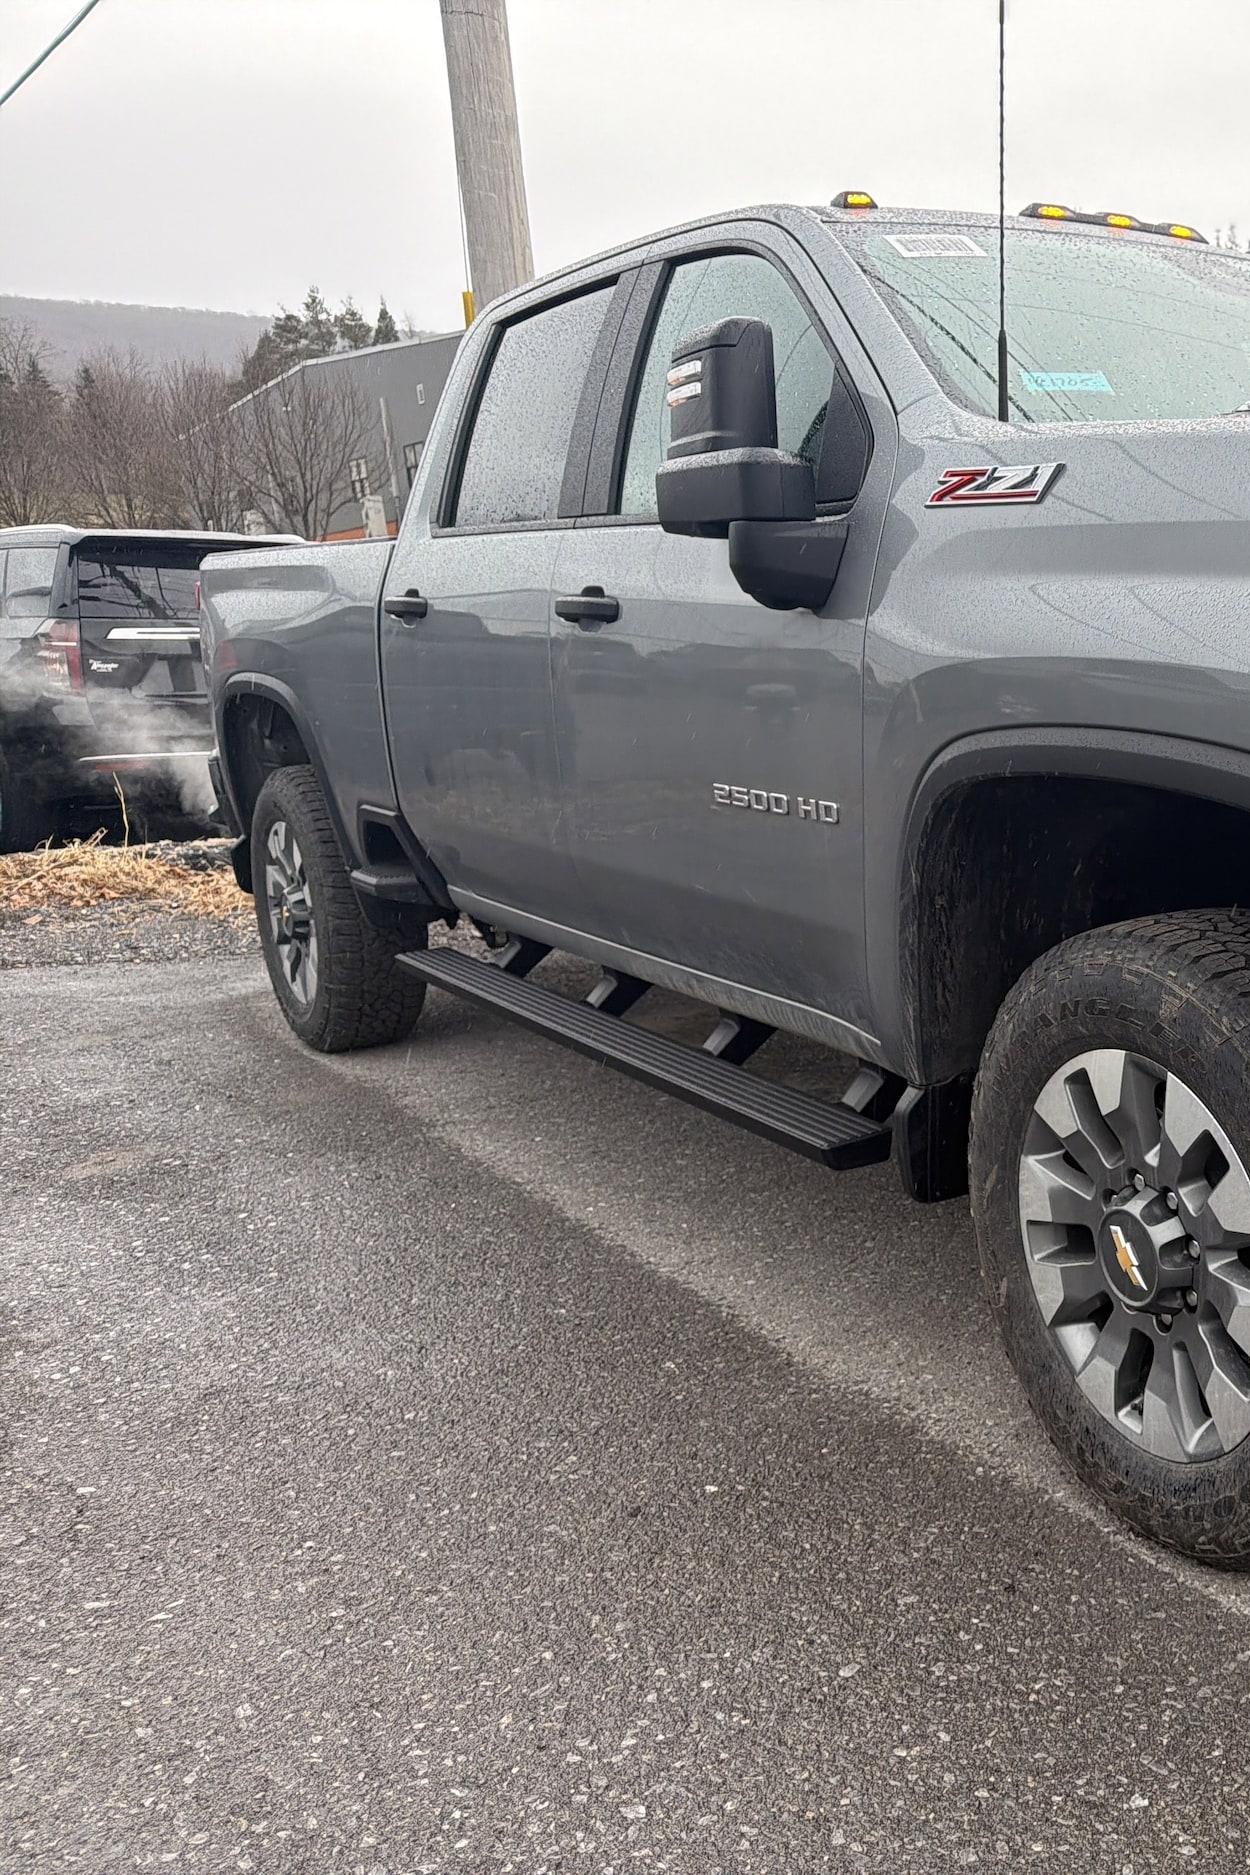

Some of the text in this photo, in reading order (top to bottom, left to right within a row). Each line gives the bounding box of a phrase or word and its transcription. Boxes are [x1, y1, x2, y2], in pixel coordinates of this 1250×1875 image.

[924, 461, 1066, 508] Z71
[712, 782, 840, 824] 2500 HD
